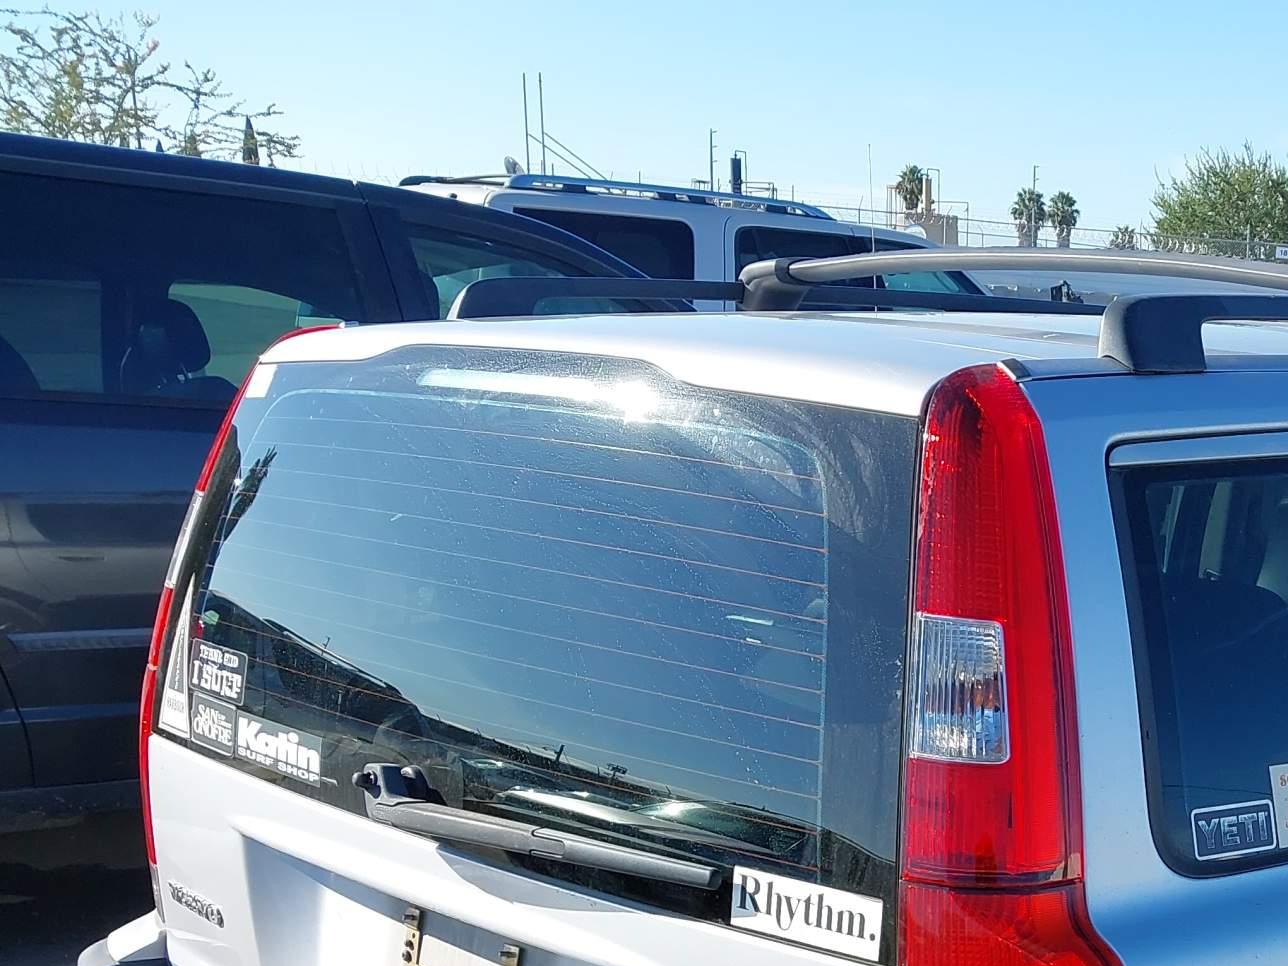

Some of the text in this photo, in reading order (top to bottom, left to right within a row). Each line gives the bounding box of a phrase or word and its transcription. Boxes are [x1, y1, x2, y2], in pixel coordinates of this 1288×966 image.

[1279, 249, 1288, 257] 18
[194, 716, 233, 746] ONOFRE
[198, 704, 219, 724] SAN
[238, 716, 321, 772] Katin
[238, 746, 319, 783] SURF SHOP
[1197, 811, 1269, 849] YETI
[737, 873, 876, 942] Rhythm.
